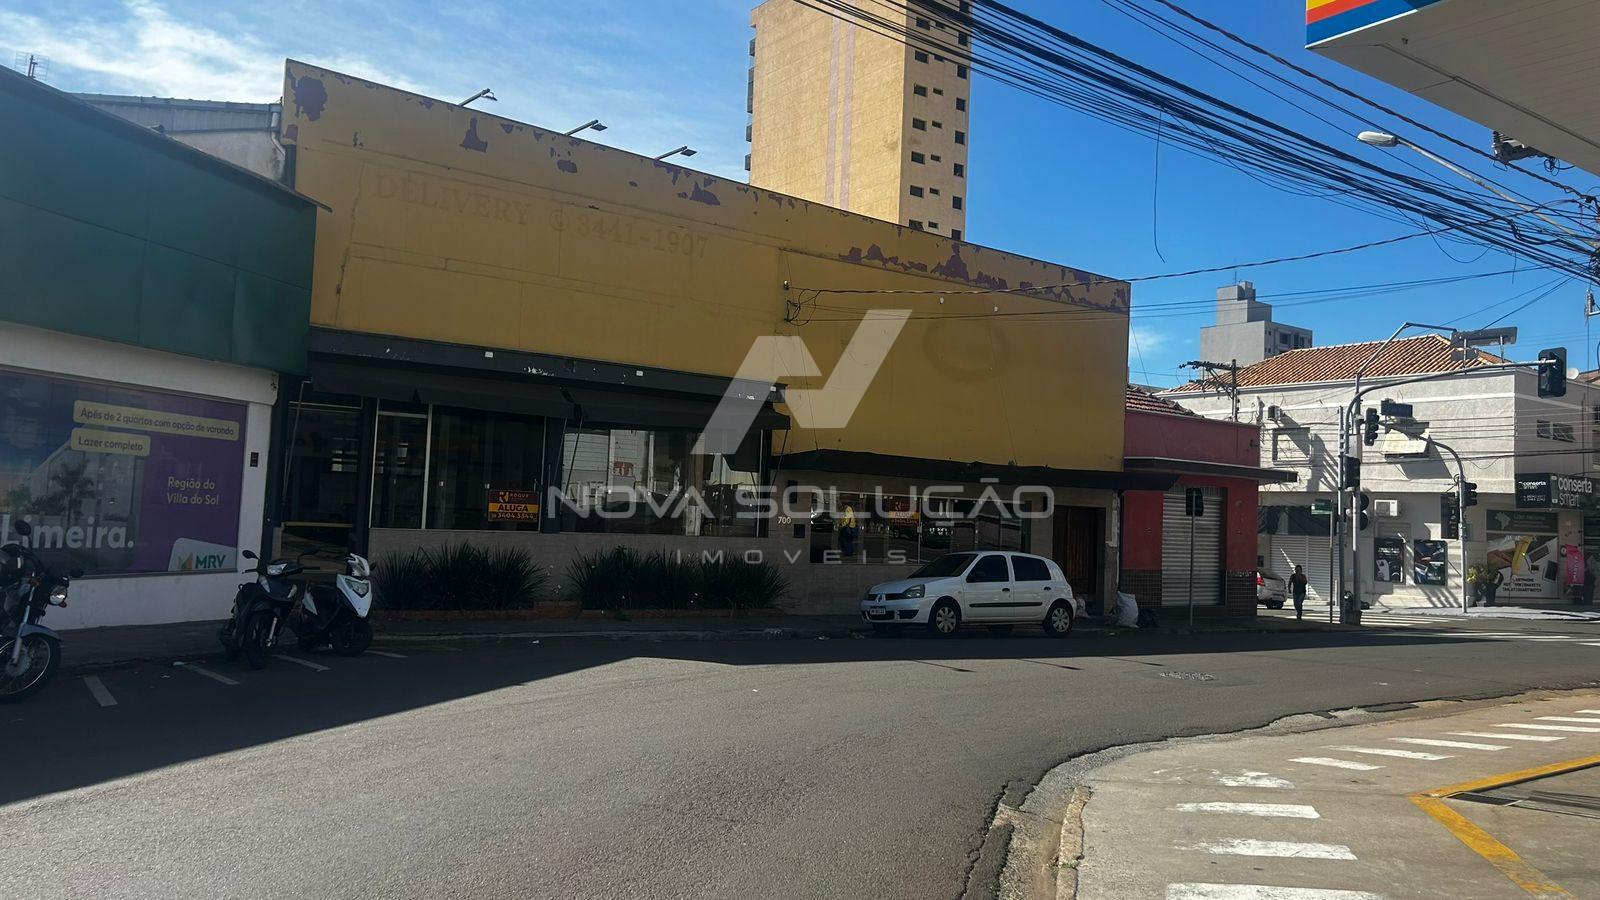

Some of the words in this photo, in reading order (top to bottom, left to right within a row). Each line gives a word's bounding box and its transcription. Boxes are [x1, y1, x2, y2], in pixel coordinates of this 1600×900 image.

[374, 173, 530, 226] DELIVERY
[576, 211, 708, 259] 3441-1907
[104, 411, 115, 421] de
[116, 412, 122, 422] 2
[123, 415, 153, 427] quartos
[155, 419, 171, 428] com
[172, 421, 195, 432] opção
[195, 424, 205, 432] de
[206, 425, 234, 436] varanda
[78, 436, 103, 448] Lazer
[104, 439, 143, 452] completo
[168, 476, 201, 491] Região
[203, 477, 215, 490] do
[1558, 477, 1593, 494] conserta
[166, 492, 188, 504] Villa
[190, 493, 203, 504] do
[205, 494, 220, 505] Sol
[1559, 493, 1580, 507] smart
[498, 504, 529, 512] ALUGA
[777, 516, 792, 525] 700
[0, 513, 134, 549] Limeira.
[195, 554, 226, 569] MRV
